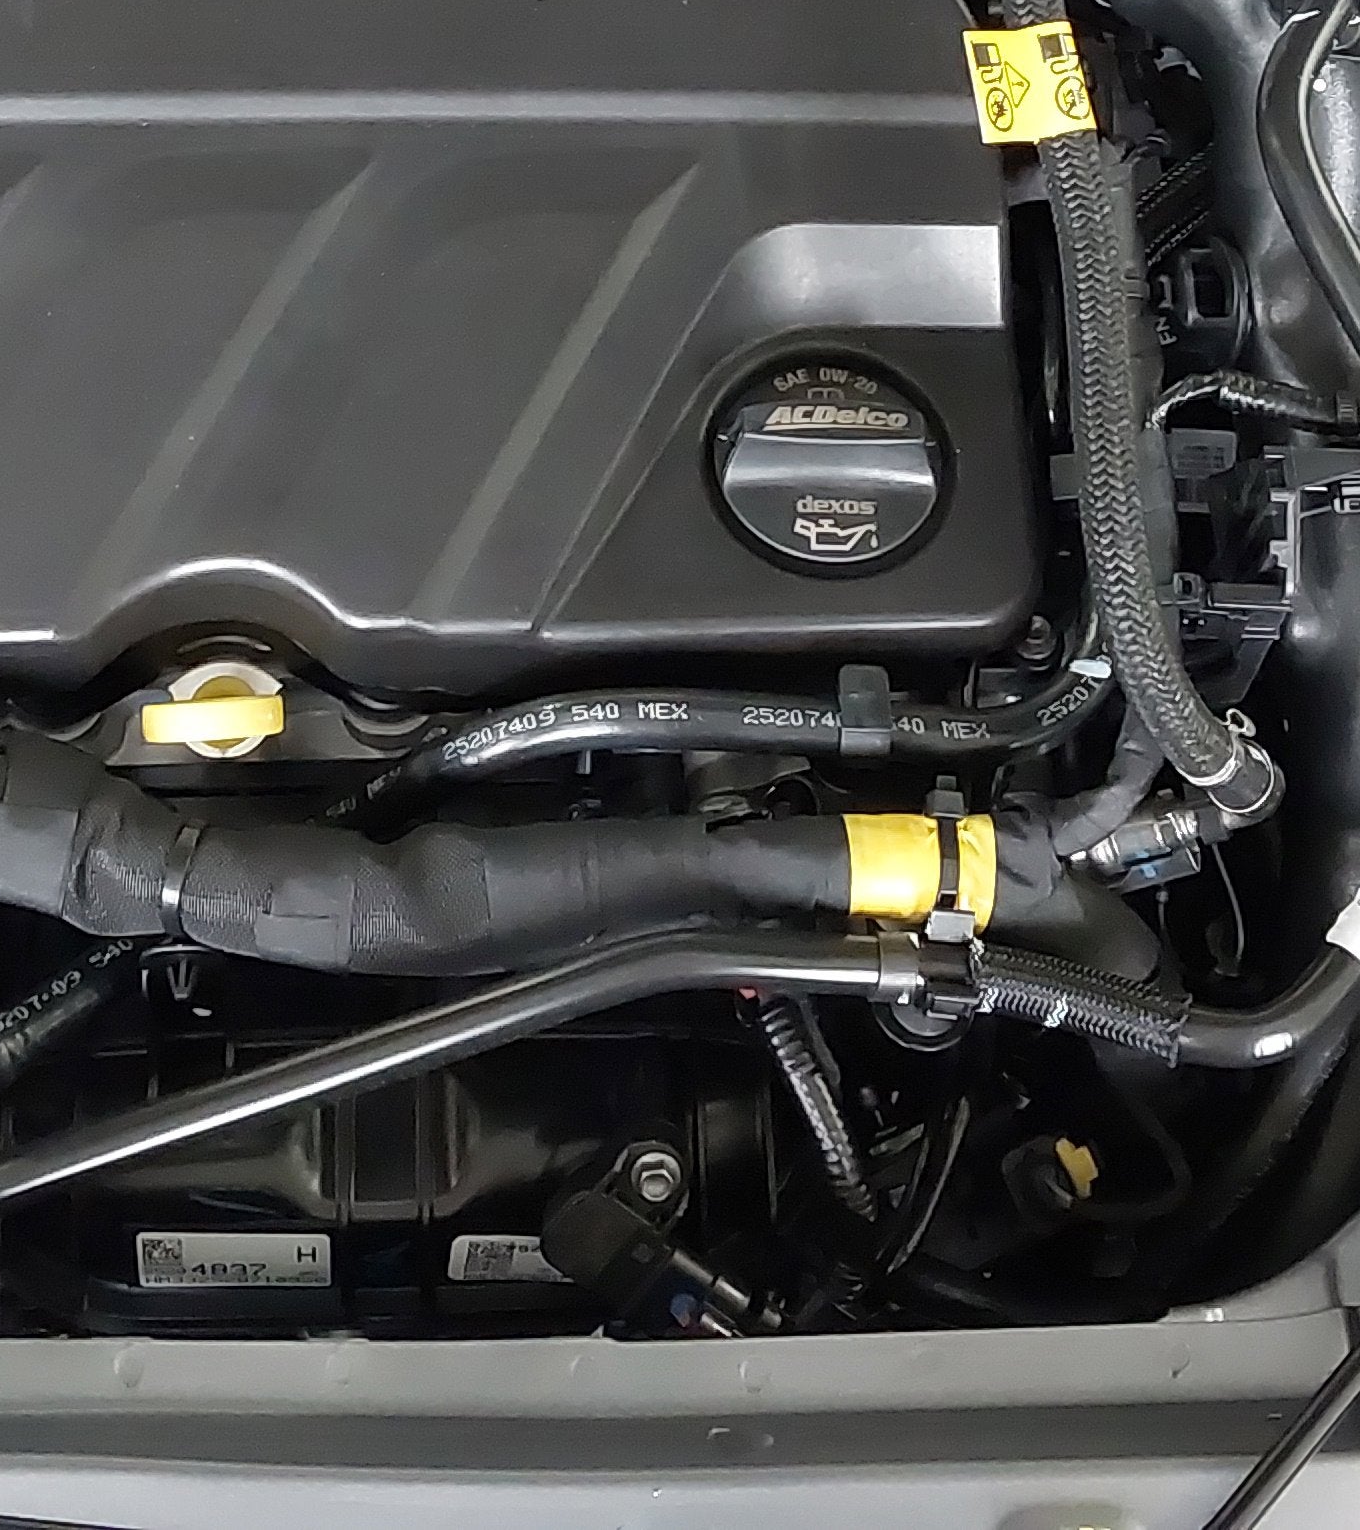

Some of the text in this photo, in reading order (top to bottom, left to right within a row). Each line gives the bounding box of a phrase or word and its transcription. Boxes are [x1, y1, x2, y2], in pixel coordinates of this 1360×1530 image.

[772, 367, 880, 396] SAE 0W-20
[764, 404, 910, 428] ACDelco
[795, 494, 878, 516] dexos
[441, 703, 557, 763] 25207409
[570, 702, 620, 723] 540
[637, 702, 690, 722] MEX
[742, 706, 842, 728] 252074
[890, 714, 925, 735] 40
[939, 719, 991, 740] MEX
[297, 1245, 317, 1262] H
